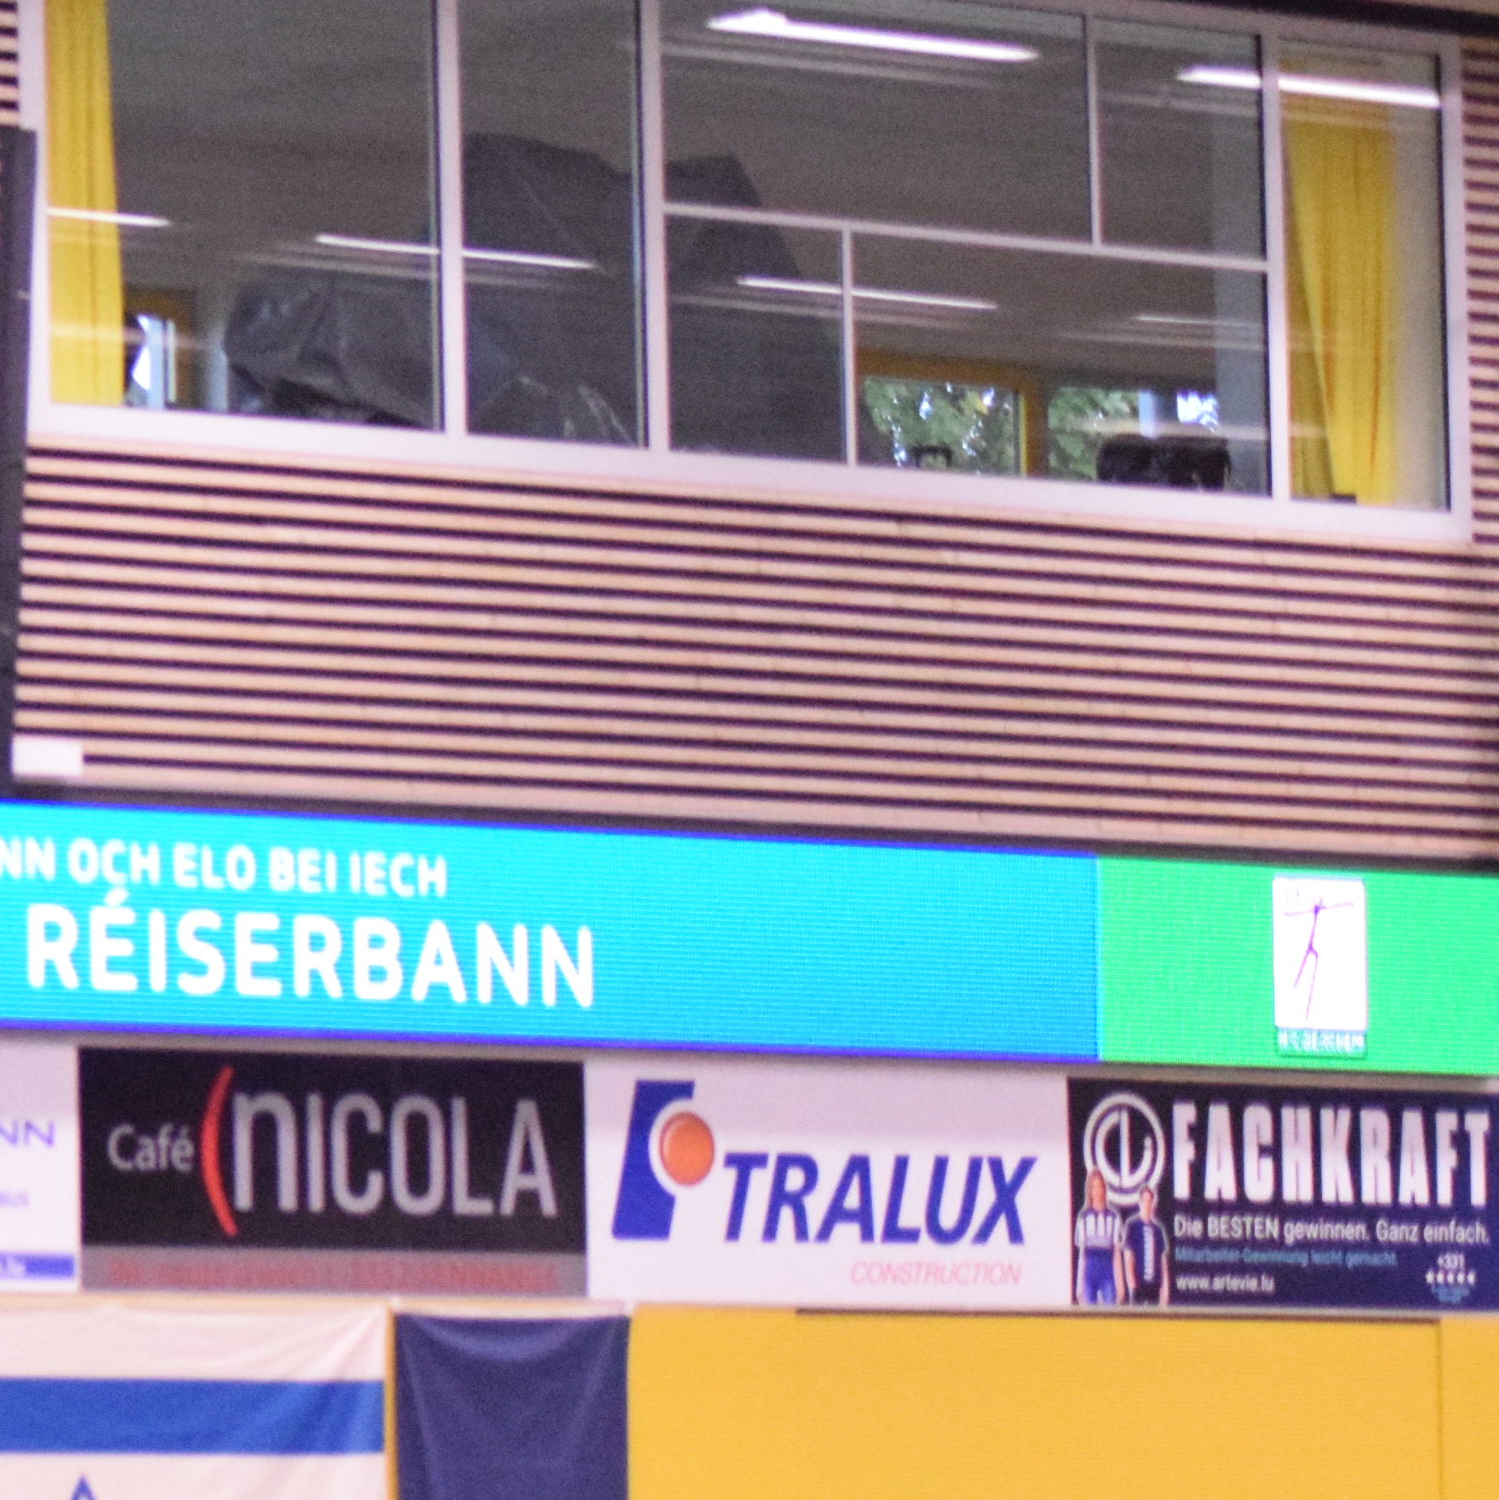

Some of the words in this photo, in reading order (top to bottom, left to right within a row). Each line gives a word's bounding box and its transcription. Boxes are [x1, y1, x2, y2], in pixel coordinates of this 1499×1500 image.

[67, 837, 162, 887] OCH
[173, 841, 256, 891] ELO
[268, 845, 337, 894] BEI
[349, 849, 447, 898] IECH
[26, 887, 594, 1009] RÉISERBANN
[108, 1124, 195, 1173] Café
[234, 1093, 558, 1217] NICOLA
[723, 1151, 1038, 1245] TRALUX
[1172, 1100, 1491, 1207] FACHKRAFT
[850, 1259, 1024, 1287] CONSTRUCTION
[1173, 1214, 1203, 1240] Die
[1207, 1215, 1280, 1240] BESTEN
[1284, 1217, 1370, 1244] gewinnen.
[1376, 1218, 1419, 1243] Ganz
[1423, 1219, 1491, 1245] einfach.
